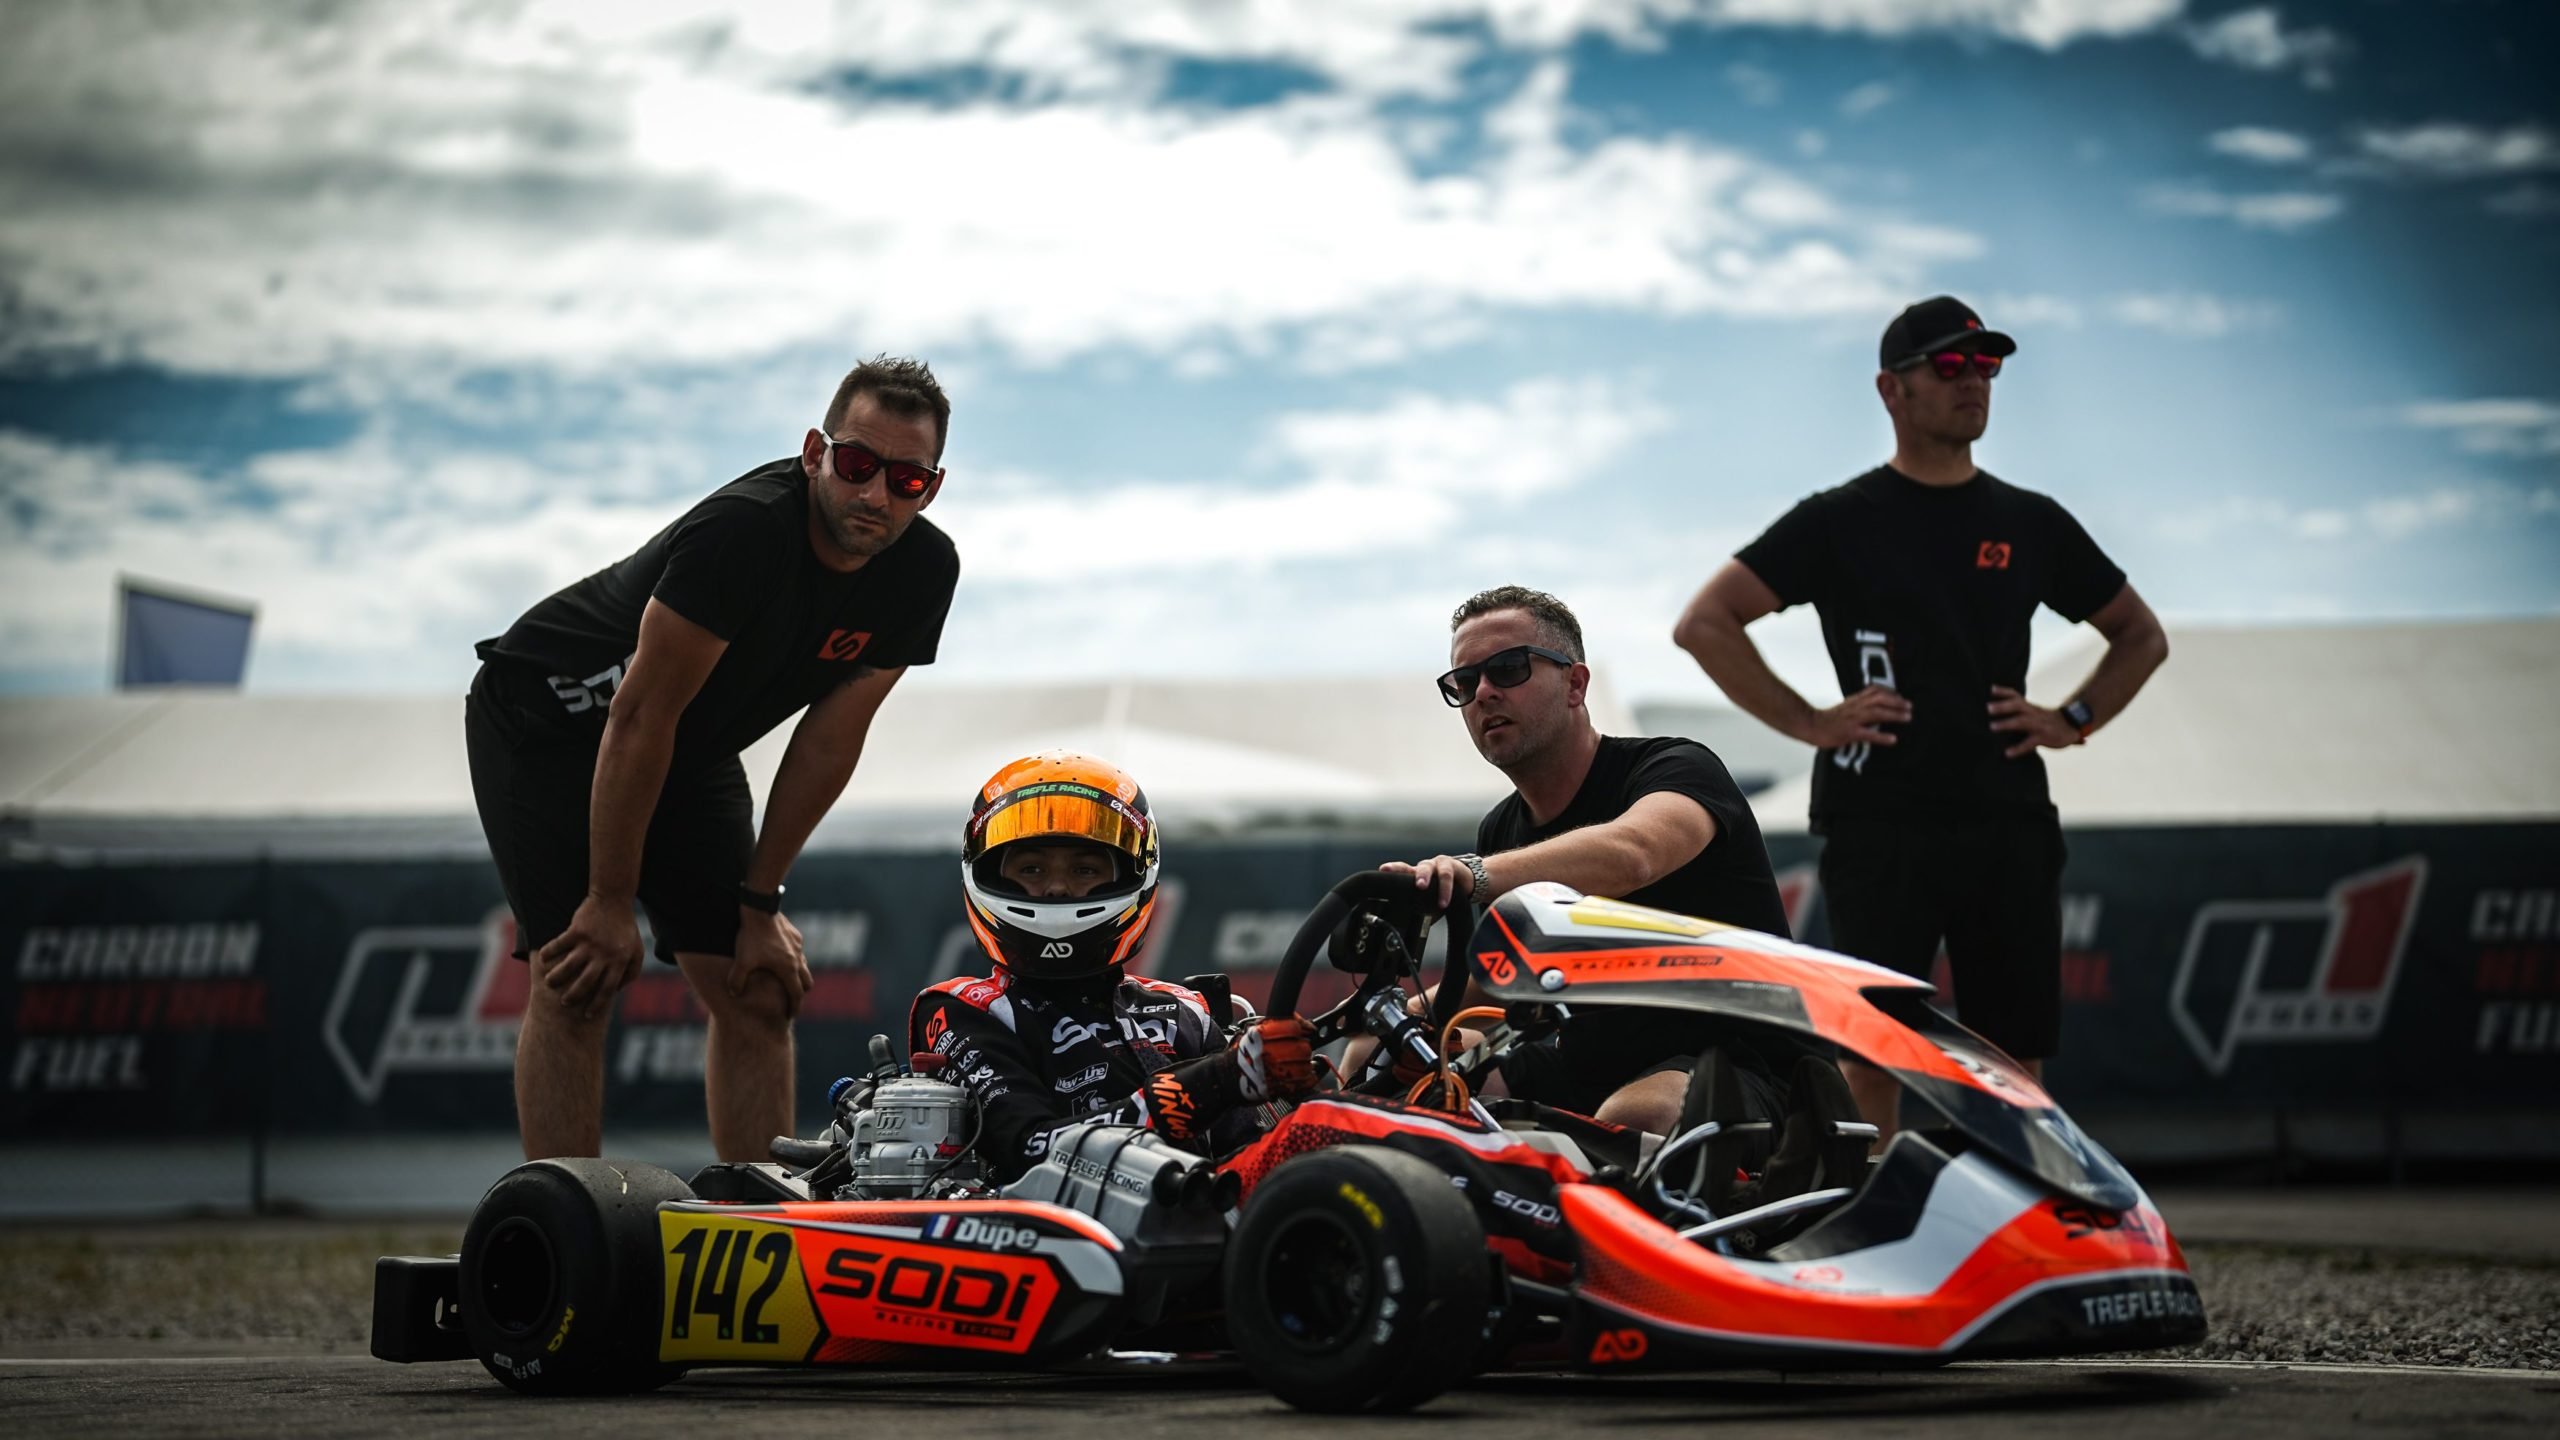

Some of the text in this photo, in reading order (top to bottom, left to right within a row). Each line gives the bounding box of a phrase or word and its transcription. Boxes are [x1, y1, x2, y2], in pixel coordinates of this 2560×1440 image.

[1016, 784, 1100, 799] TREFLE RACING
[15, 923, 261, 978] CARBON
[8, 1034, 148, 1090] FUEL
[1054, 1151, 1098, 1179] TRFLE
[954, 1217, 1038, 1251] Dupe
[670, 1228, 793, 1344] 142
[875, 1310, 949, 1331] RACING
[2080, 1291, 2164, 1326] TREFLE
